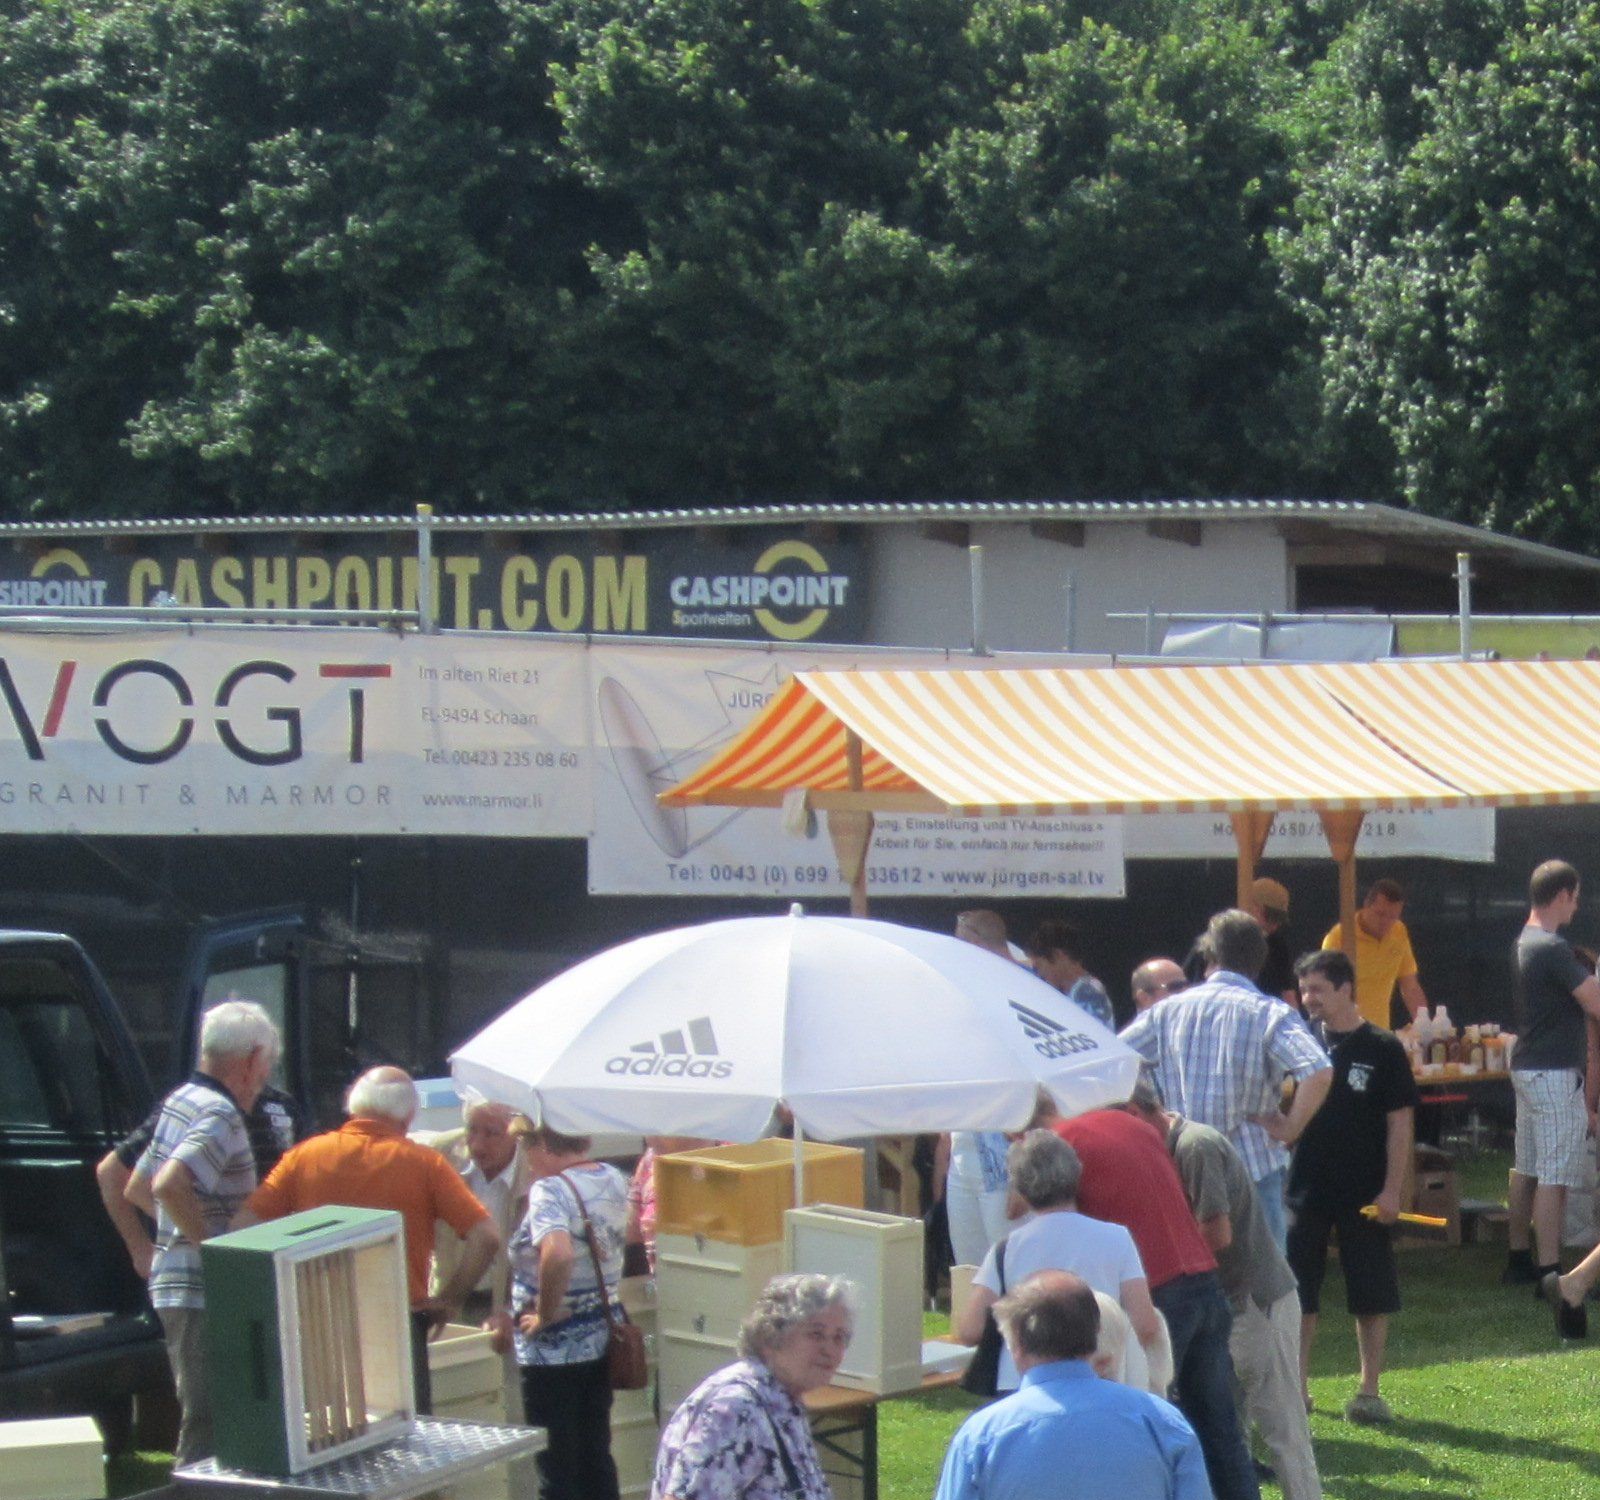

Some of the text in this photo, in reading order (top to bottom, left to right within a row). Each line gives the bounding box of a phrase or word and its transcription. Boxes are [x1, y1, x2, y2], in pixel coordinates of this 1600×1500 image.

[128, 556, 650, 632] CASHPOINT.COM
[670, 576, 848, 606] CASHPOINT
[419, 666, 438, 680] Im
[442, 667, 483, 683] alten
[488, 667, 518, 684] Riet
[0, 657, 392, 766] VOGT
[483, 709, 538, 726] Schaan
[452, 750, 498, 766] 00423
[504, 751, 530, 767] 235
[535, 752, 554, 767] 08
[559, 752, 578, 768] 60
[0, 781, 392, 807] GRANIT & MARMOR
[422, 792, 543, 810] www.marmor.li
[905, 817, 979, 834] Einstellung
[668, 863, 702, 882] Tel:
[710, 865, 757, 883] 0043
[763, 866, 789, 886] (0)
[794, 866, 828, 883] 699
[1034, 1032, 1099, 1059] adidas
[604, 1053, 734, 1079] adidas
